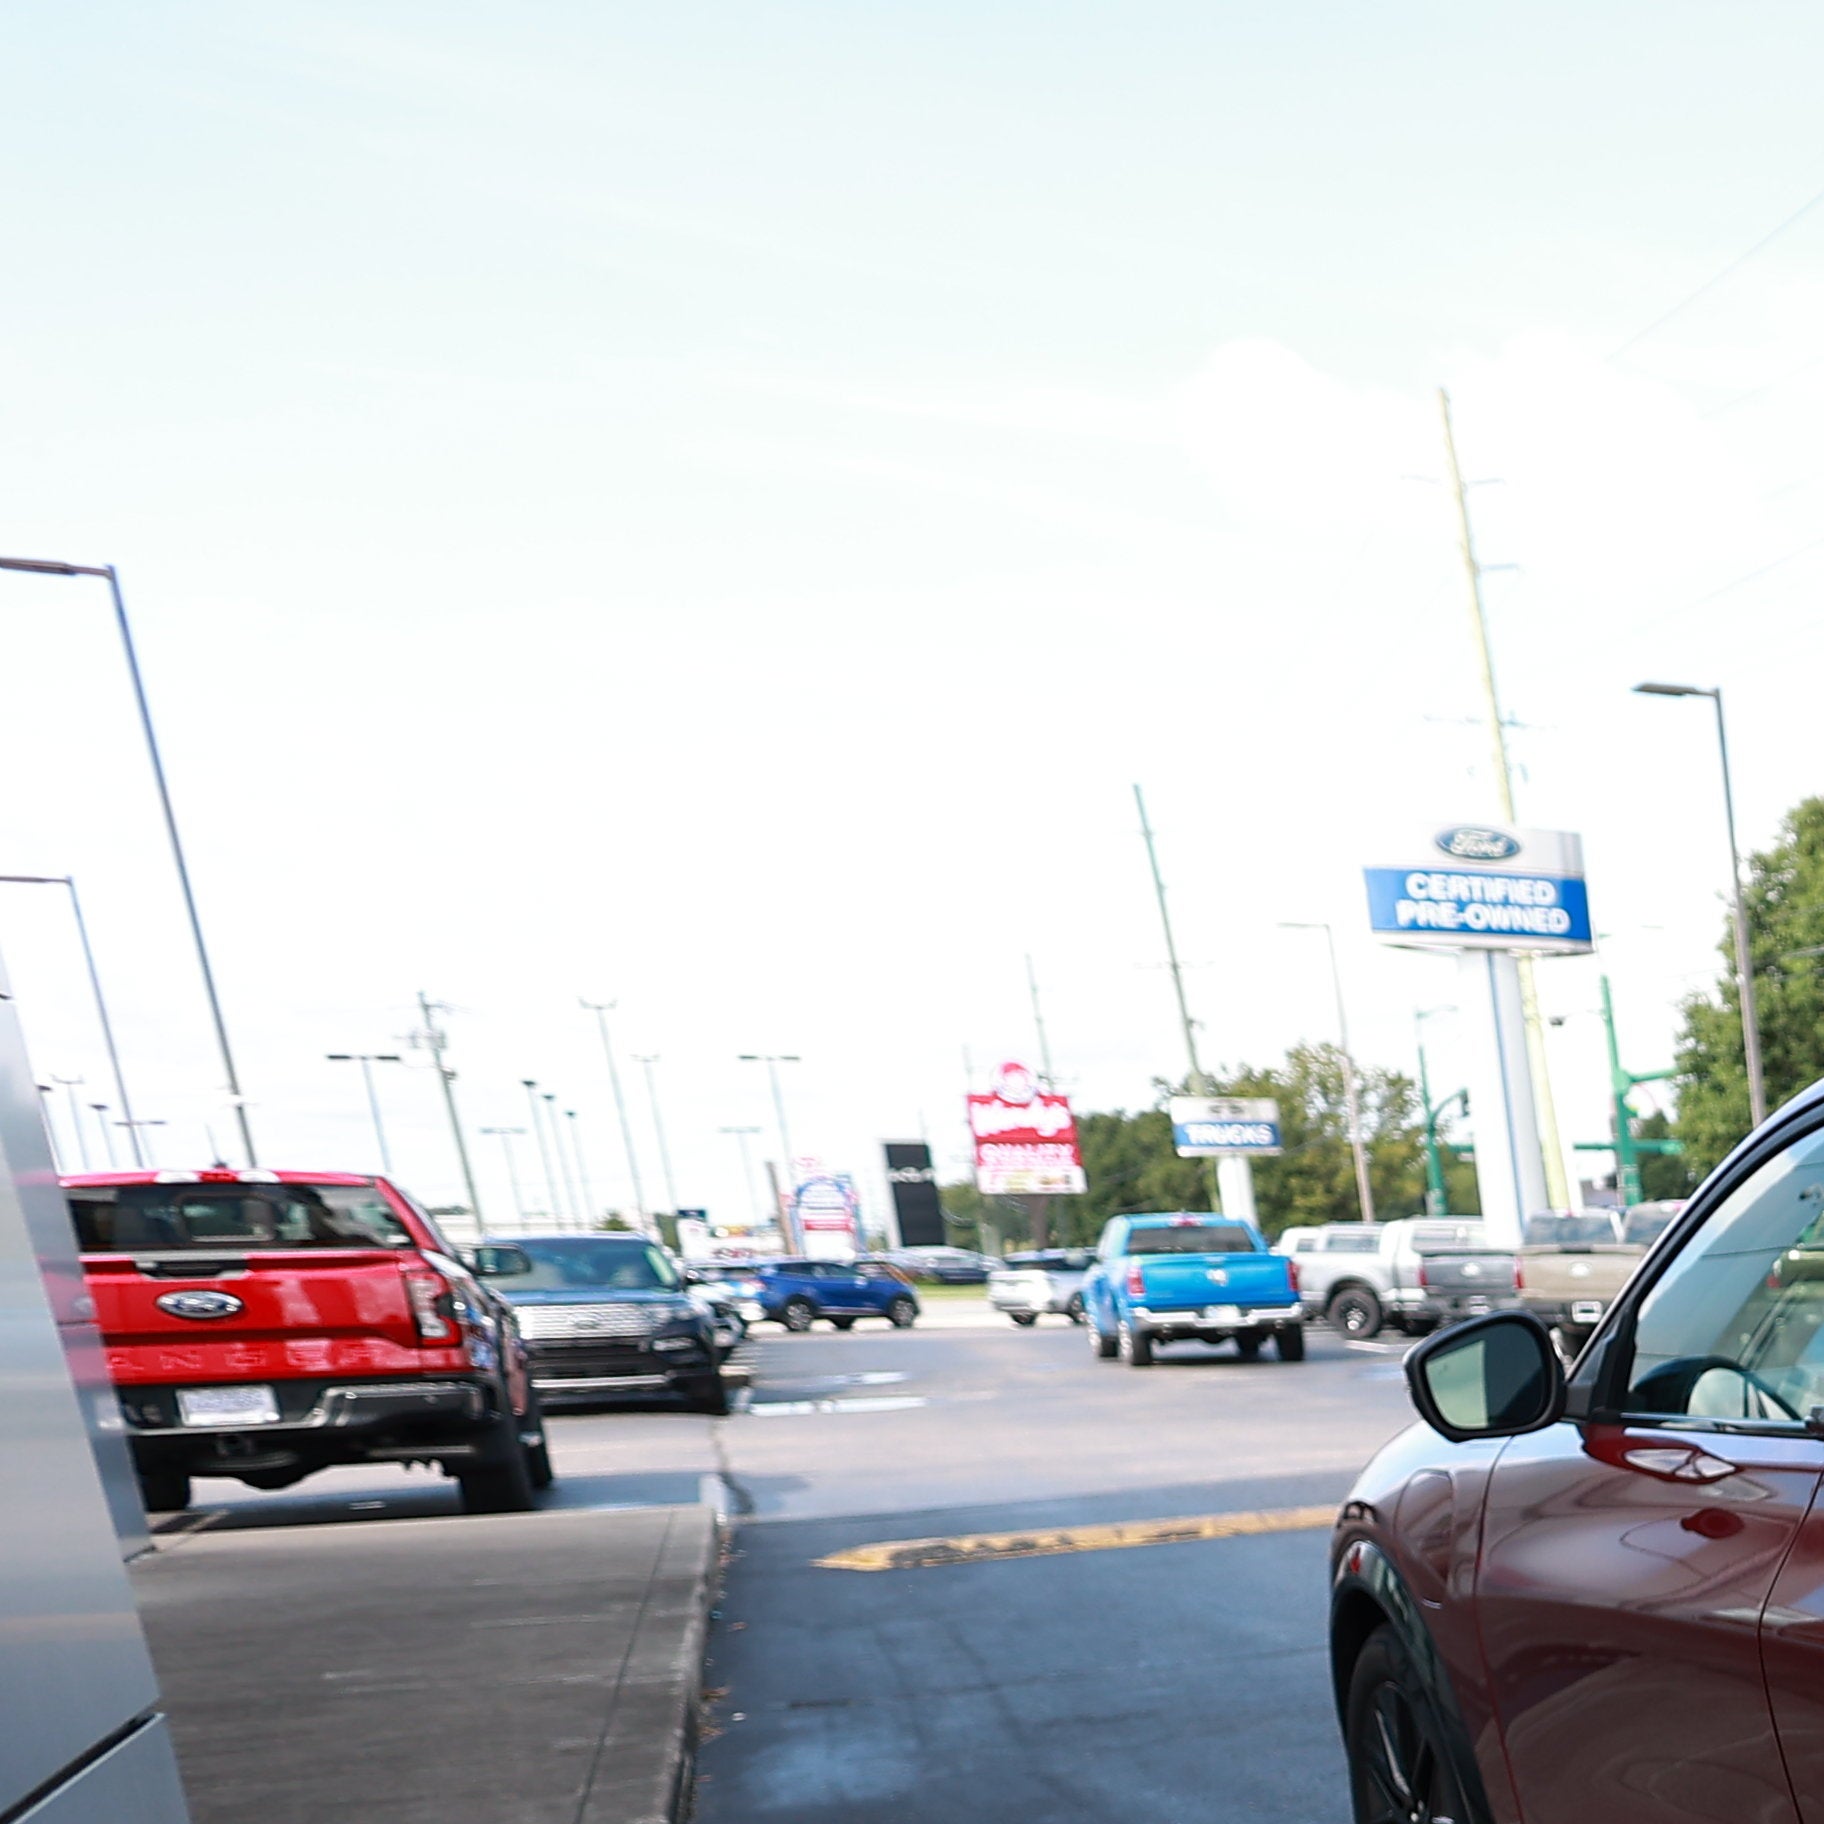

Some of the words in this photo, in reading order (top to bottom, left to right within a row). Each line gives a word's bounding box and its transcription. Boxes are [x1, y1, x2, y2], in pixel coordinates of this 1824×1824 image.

[1405, 871, 1557, 905] CERTIFIED
[1394, 899, 1572, 934] PRE-OWNED
[1183, 1123, 1274, 1145] TRUCKS
